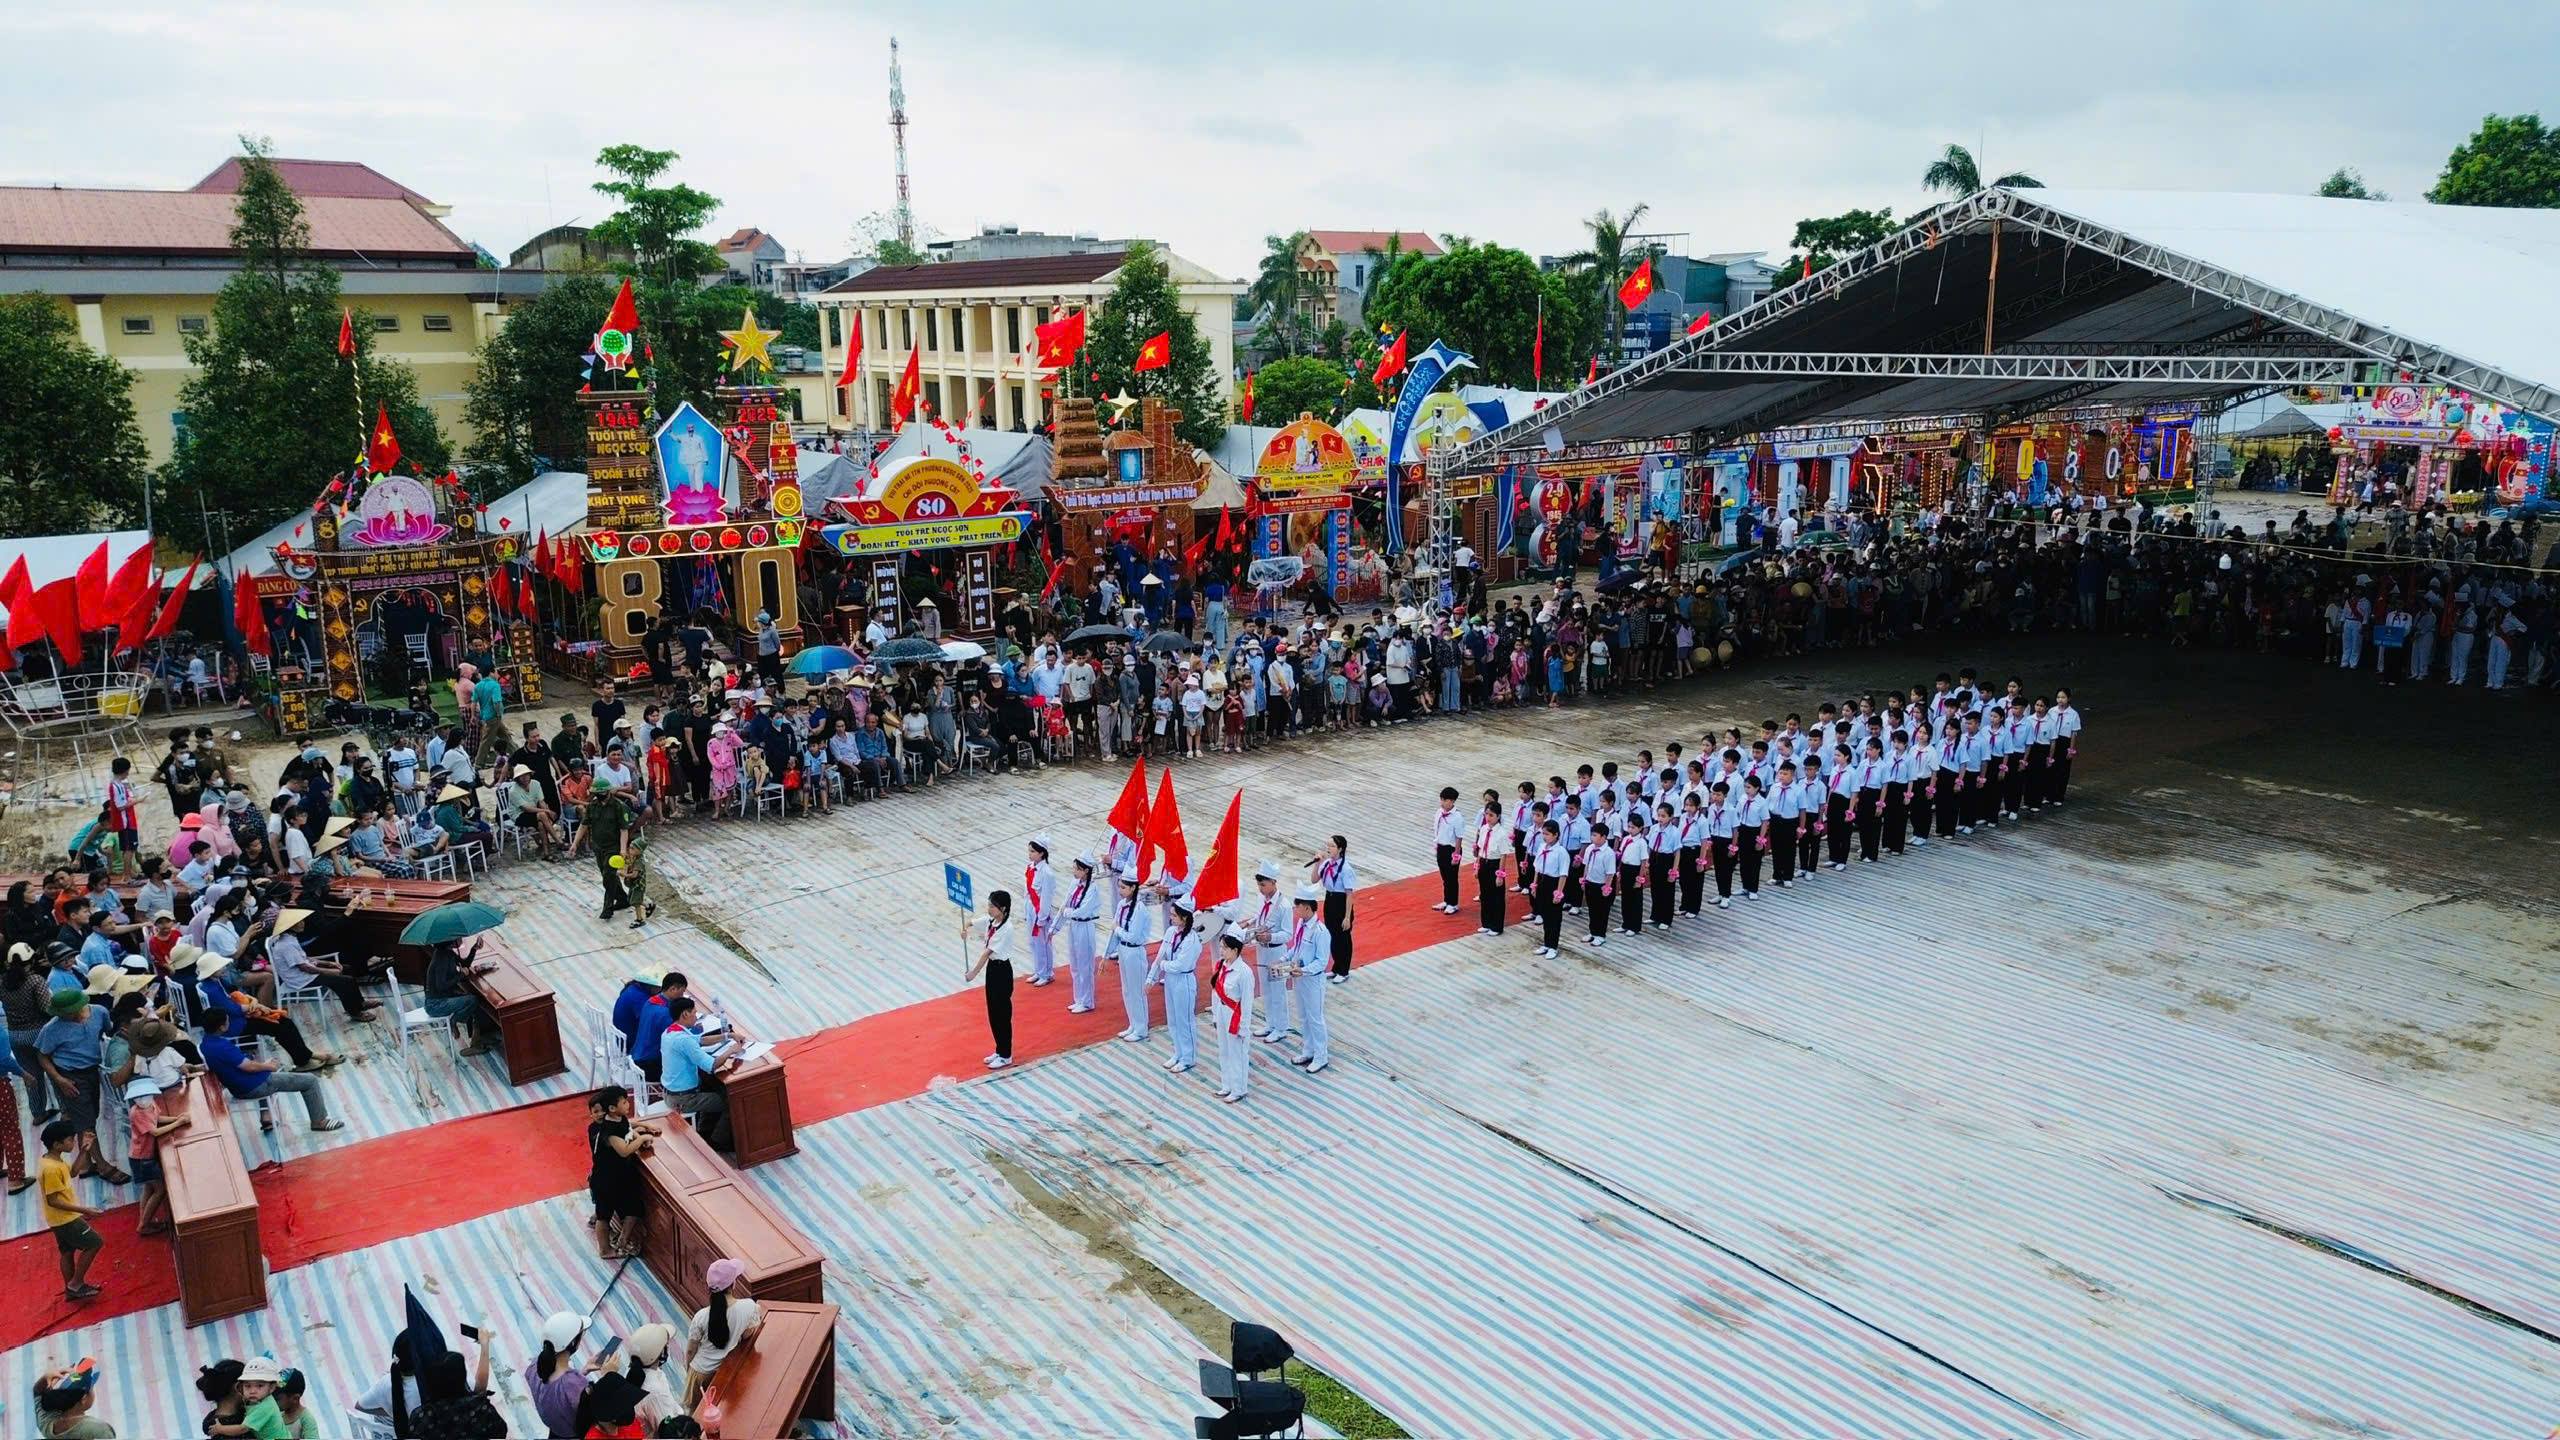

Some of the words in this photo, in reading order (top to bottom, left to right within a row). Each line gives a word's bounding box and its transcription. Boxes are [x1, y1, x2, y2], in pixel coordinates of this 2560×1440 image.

[595, 412, 639, 427] 1945
[738, 406, 777, 422] 2025
[1546, 483, 1564, 498] 2-9
[915, 497, 946, 517] 80
